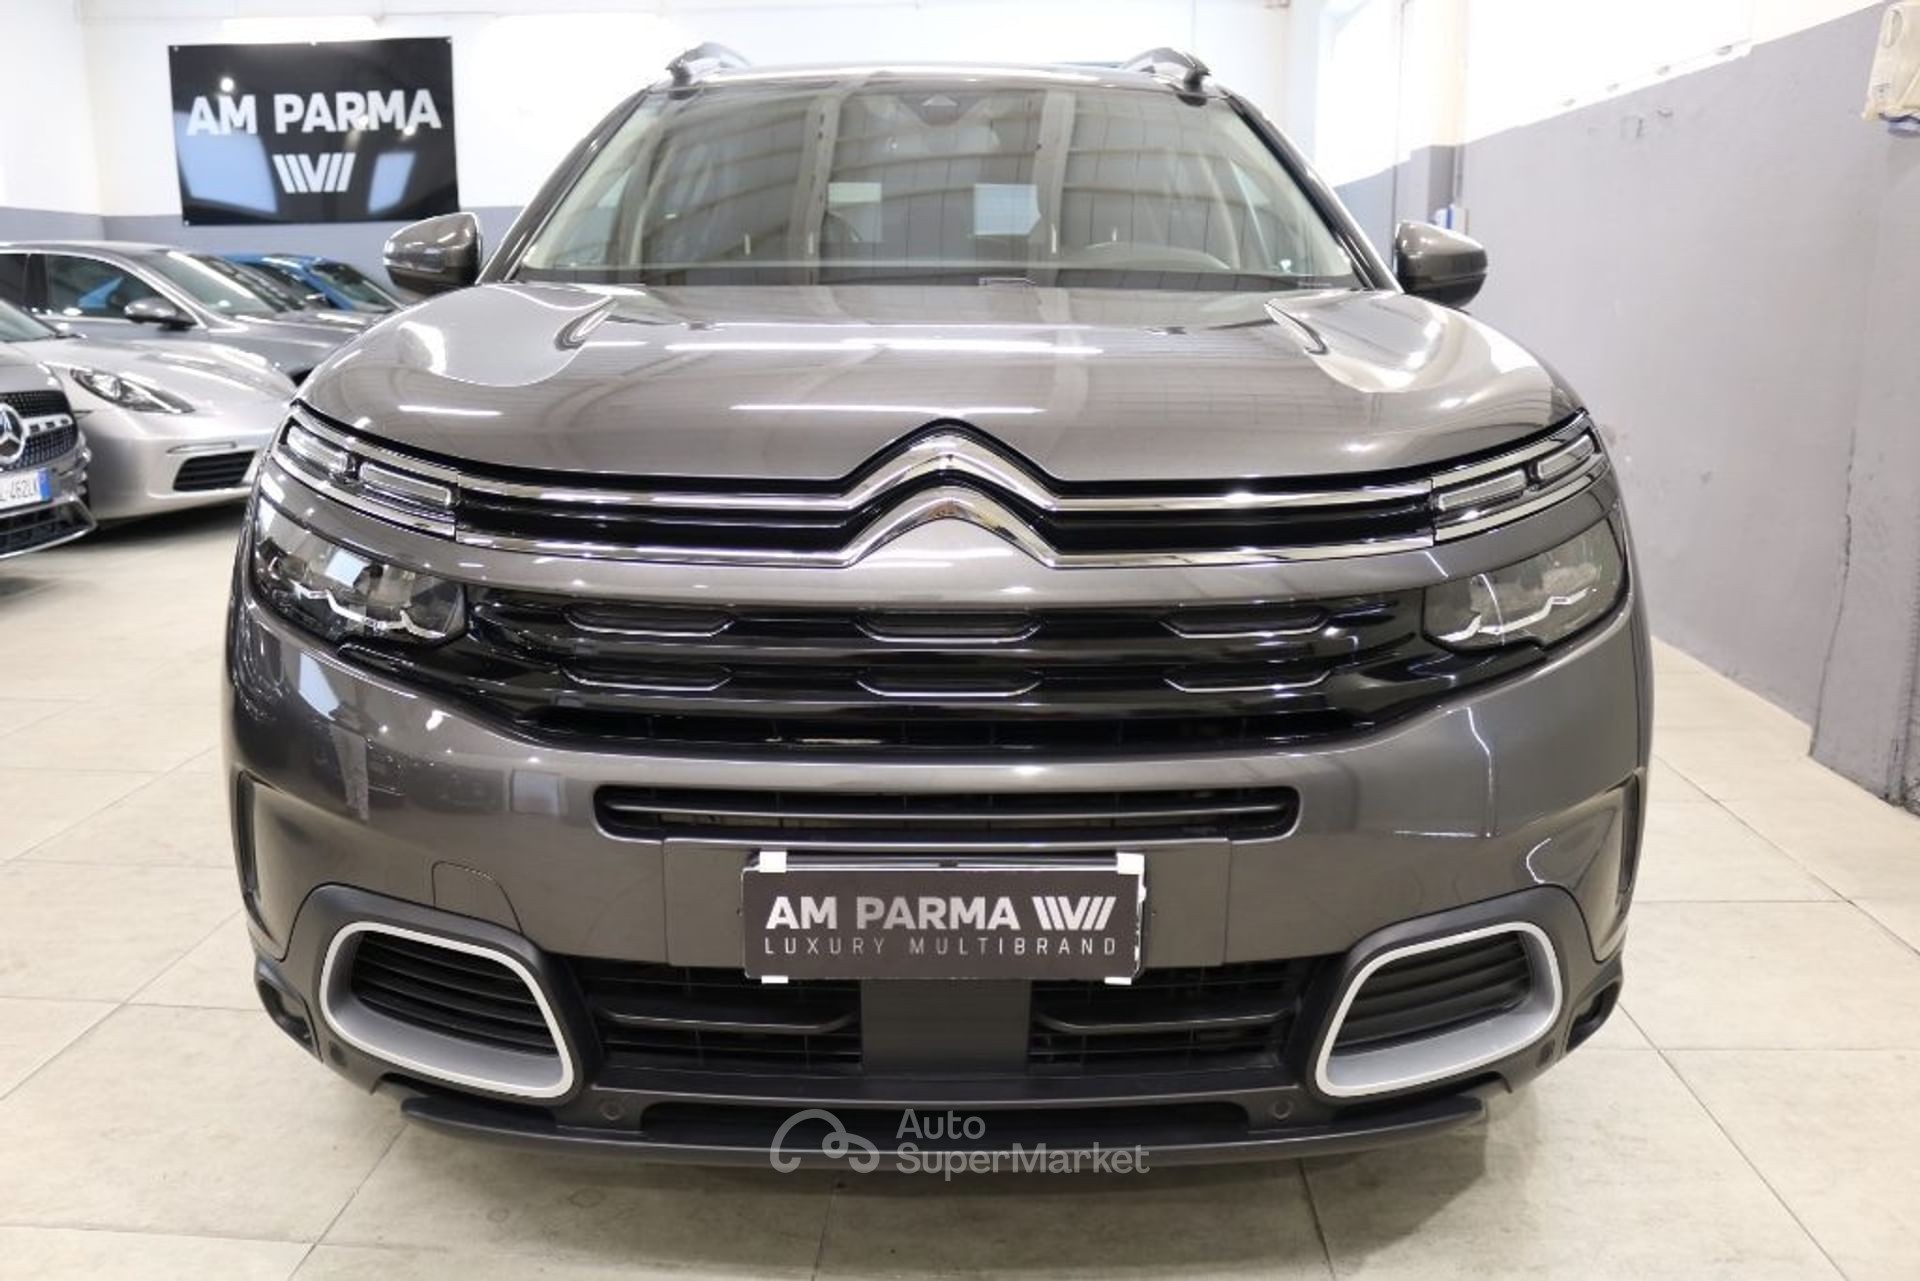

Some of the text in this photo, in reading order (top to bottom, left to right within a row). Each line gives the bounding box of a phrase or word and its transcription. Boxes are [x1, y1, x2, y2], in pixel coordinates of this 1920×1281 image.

[186, 88, 442, 136] AM PARMA
[765, 896, 1021, 930] AM PARMA
[765, 937, 1116, 955] LUXURY MULTIBRAND
